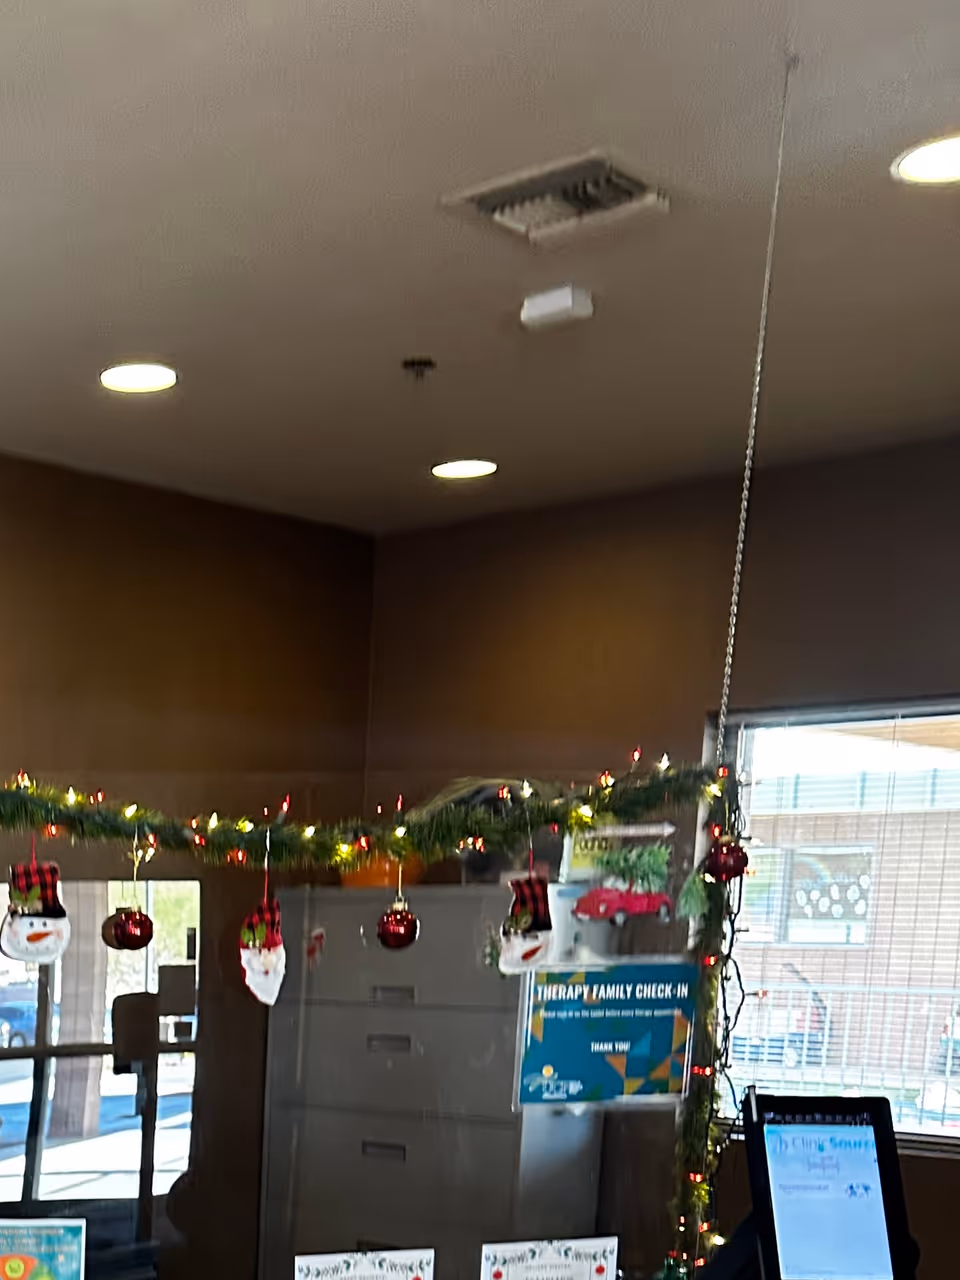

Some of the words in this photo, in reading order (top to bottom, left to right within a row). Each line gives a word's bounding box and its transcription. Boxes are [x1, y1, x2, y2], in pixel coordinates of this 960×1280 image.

[537, 984, 590, 1000] THERAPY
[592, 983, 632, 999] FAMILY
[636, 982, 688, 999] CHECK-IN
[591, 1042, 613, 1053] THANK
